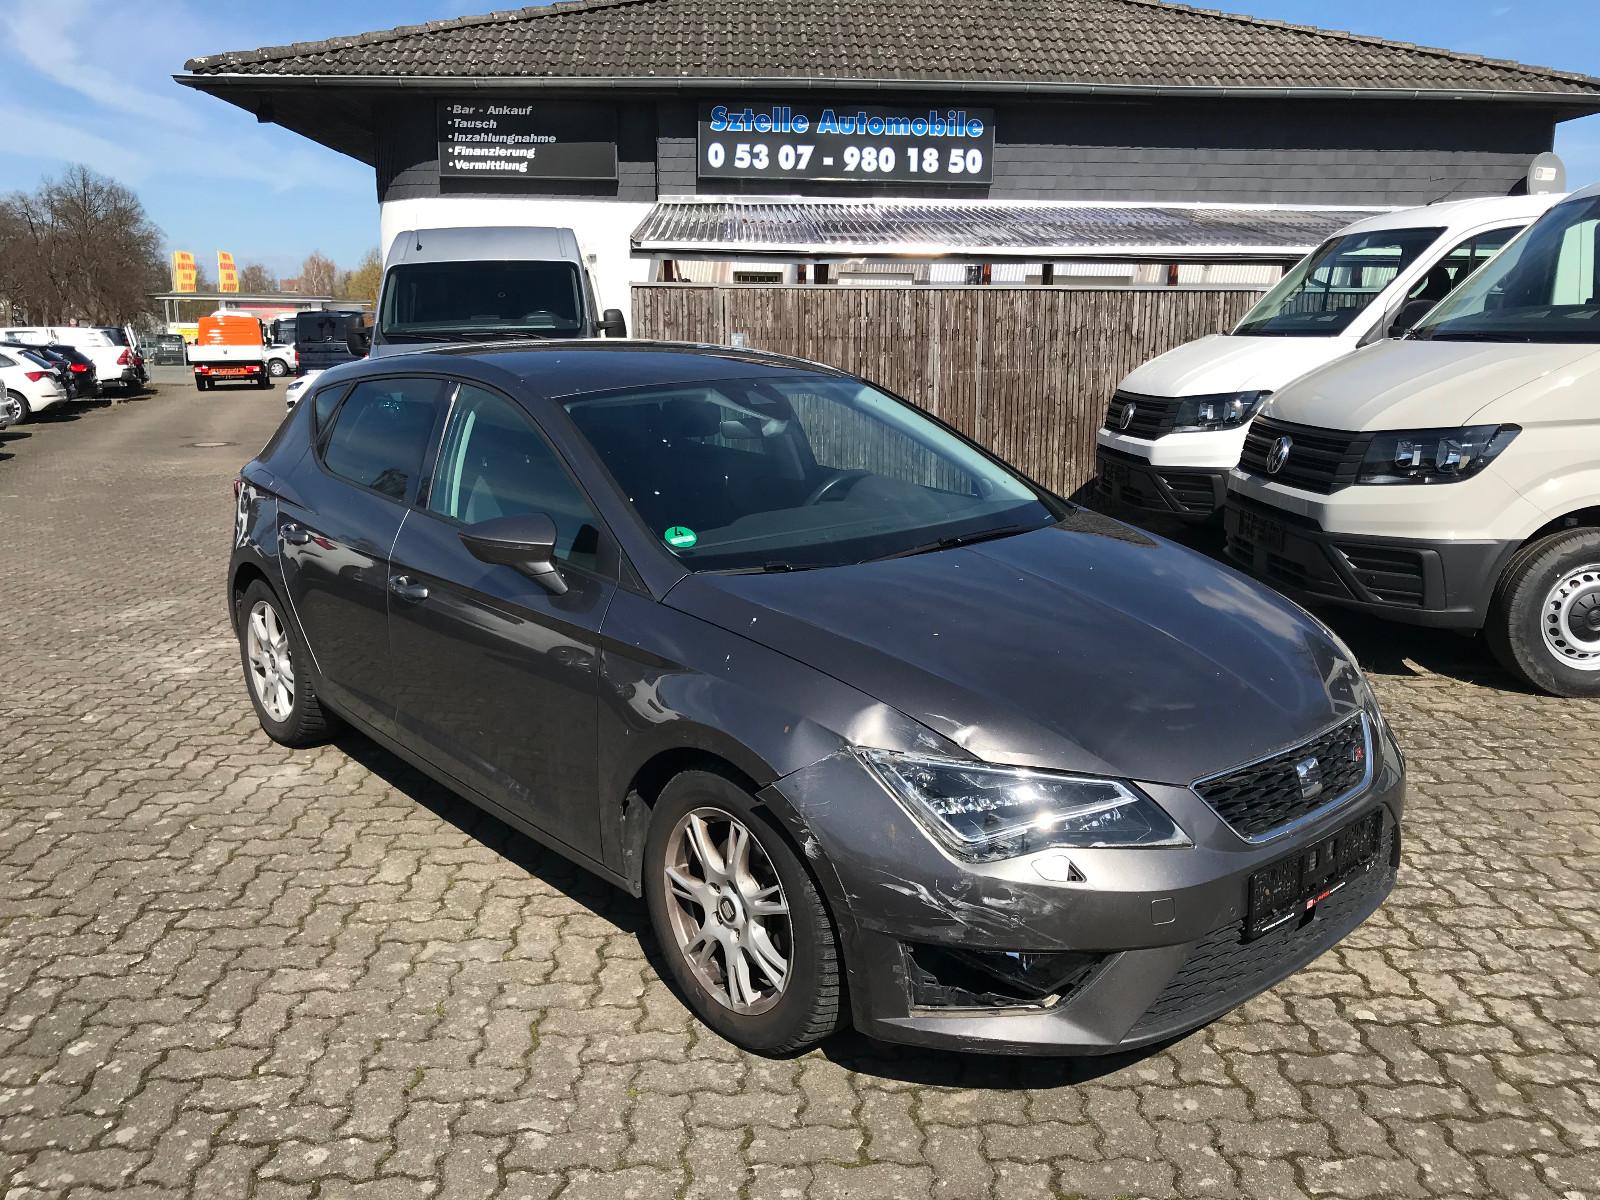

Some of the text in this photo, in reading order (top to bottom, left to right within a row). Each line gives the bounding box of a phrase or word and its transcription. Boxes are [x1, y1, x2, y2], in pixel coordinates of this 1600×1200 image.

[453, 105, 475, 114] Bar
[486, 105, 533, 115] Ankauf
[454, 119, 497, 129] Tausch
[709, 106, 984, 137] Sztelle Automobile
[454, 132, 557, 145] Inzahlungnahme
[453, 146, 536, 159] Finanzierung
[707, 142, 725, 168] 0
[734, 143, 770, 170] 53
[778, 144, 816, 170] 07
[843, 146, 896, 172] 980
[907, 147, 940, 173] 18
[948, 148, 983, 174] 50
[454, 160, 529, 173] Vermittlung
